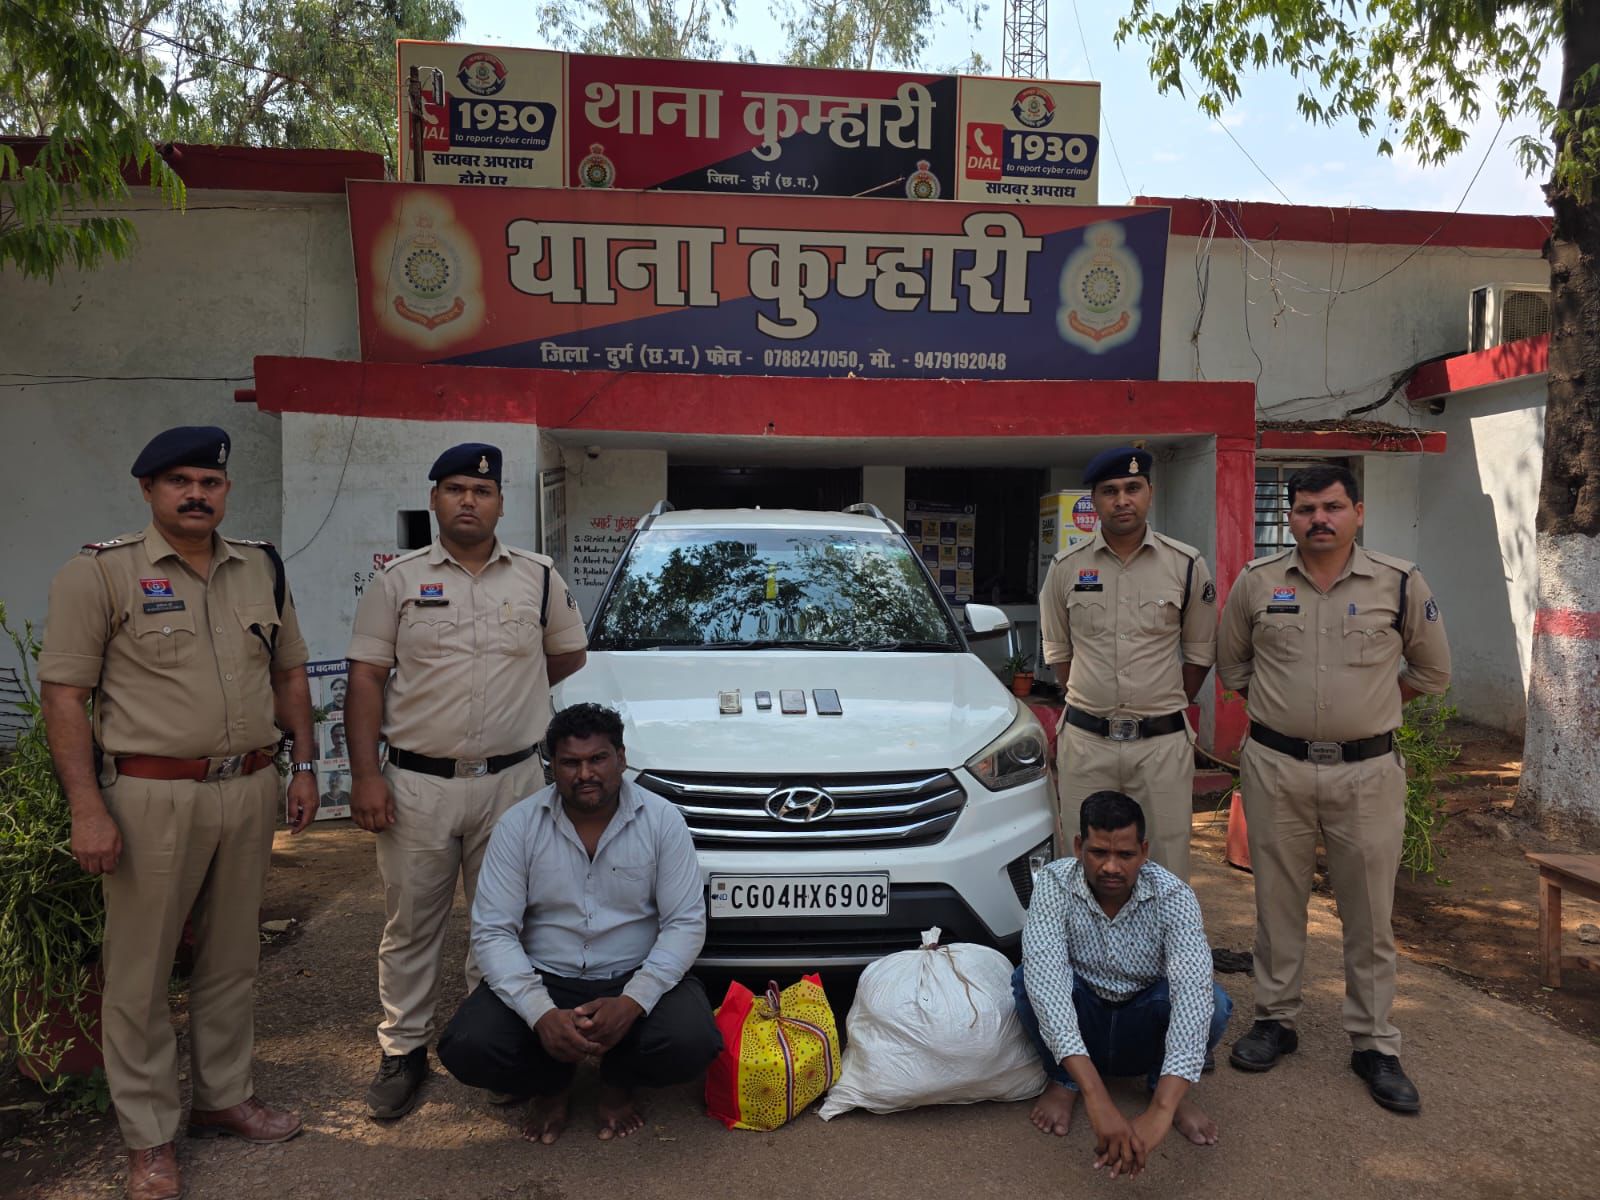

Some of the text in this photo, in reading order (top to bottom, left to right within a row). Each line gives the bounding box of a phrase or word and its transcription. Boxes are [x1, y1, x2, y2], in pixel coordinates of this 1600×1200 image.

[458, 102, 545, 133] 1930
[584, 82, 936, 161] थाना कुम्हारी
[466, 135, 493, 143] report
[495, 136, 519, 145] cyber
[521, 137, 546, 145] crime
[1011, 134, 1088, 163] 1930
[432, 153, 534, 169] सायबर अपराध
[968, 156, 1000, 170] DIAL
[1017, 164, 1040, 173] report
[1042, 166, 1064, 175] cyber
[1066, 167, 1088, 175] crime
[459, 170, 508, 185] होने पर
[752, 171, 770, 190] दुर्ग
[776, 174, 818, 191] (छ.ग.)
[986, 183, 1076, 198] सायबर अपराध
[506, 211, 1044, 339] थाना कुम्हारी
[605, 343, 633, 368] दुर्ग
[640, 344, 699, 369] (छ.ग.)
[706, 345, 742, 366] फोन
[914, 352, 1006, 370] 9479192048
[1076, 516, 1095, 524] 1933
[731, 884, 884, 909] CG04HX6908
